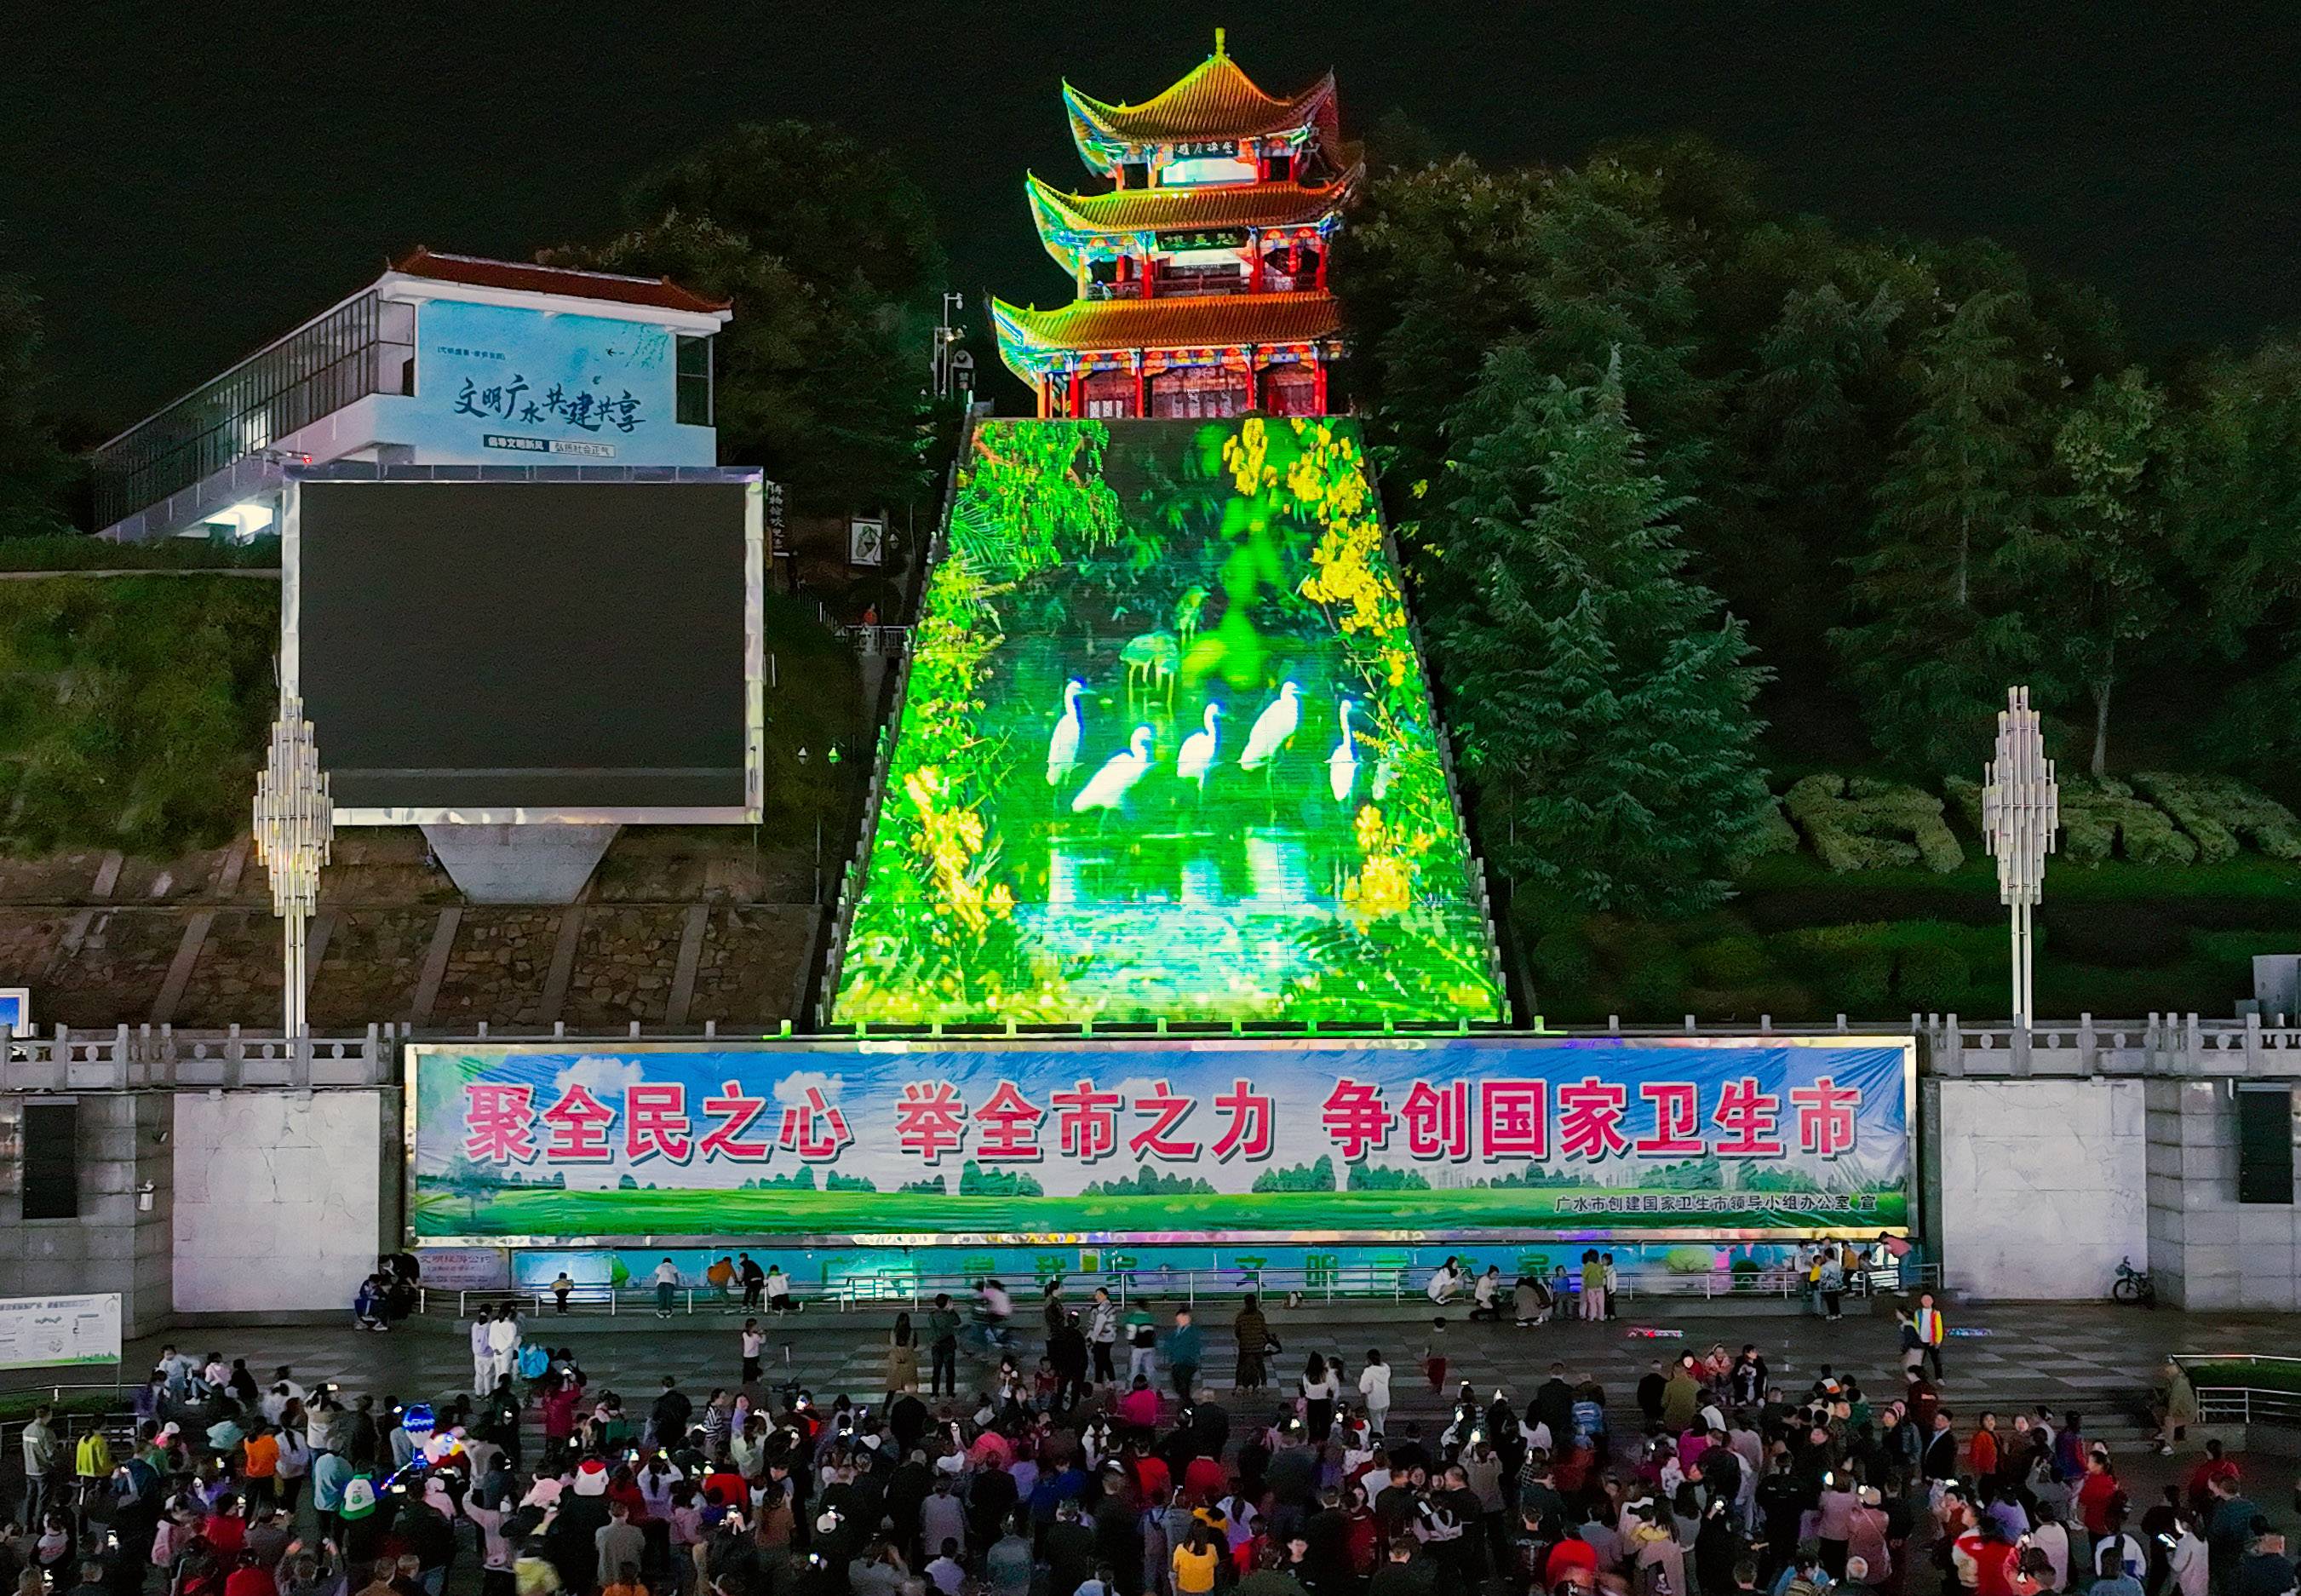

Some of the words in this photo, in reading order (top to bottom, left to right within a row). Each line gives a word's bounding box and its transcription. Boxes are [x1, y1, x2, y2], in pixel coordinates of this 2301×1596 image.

[464, 1080, 854, 1164] 聚全民之心
[894, 1077, 1277, 1165] 举全市之力
[1321, 1077, 1865, 1162] 争创国家卫生市
[1555, 1194, 1851, 1213] 广水市创建国家卫生市领导小组办公室
[1859, 1195, 1877, 1212] 宣
